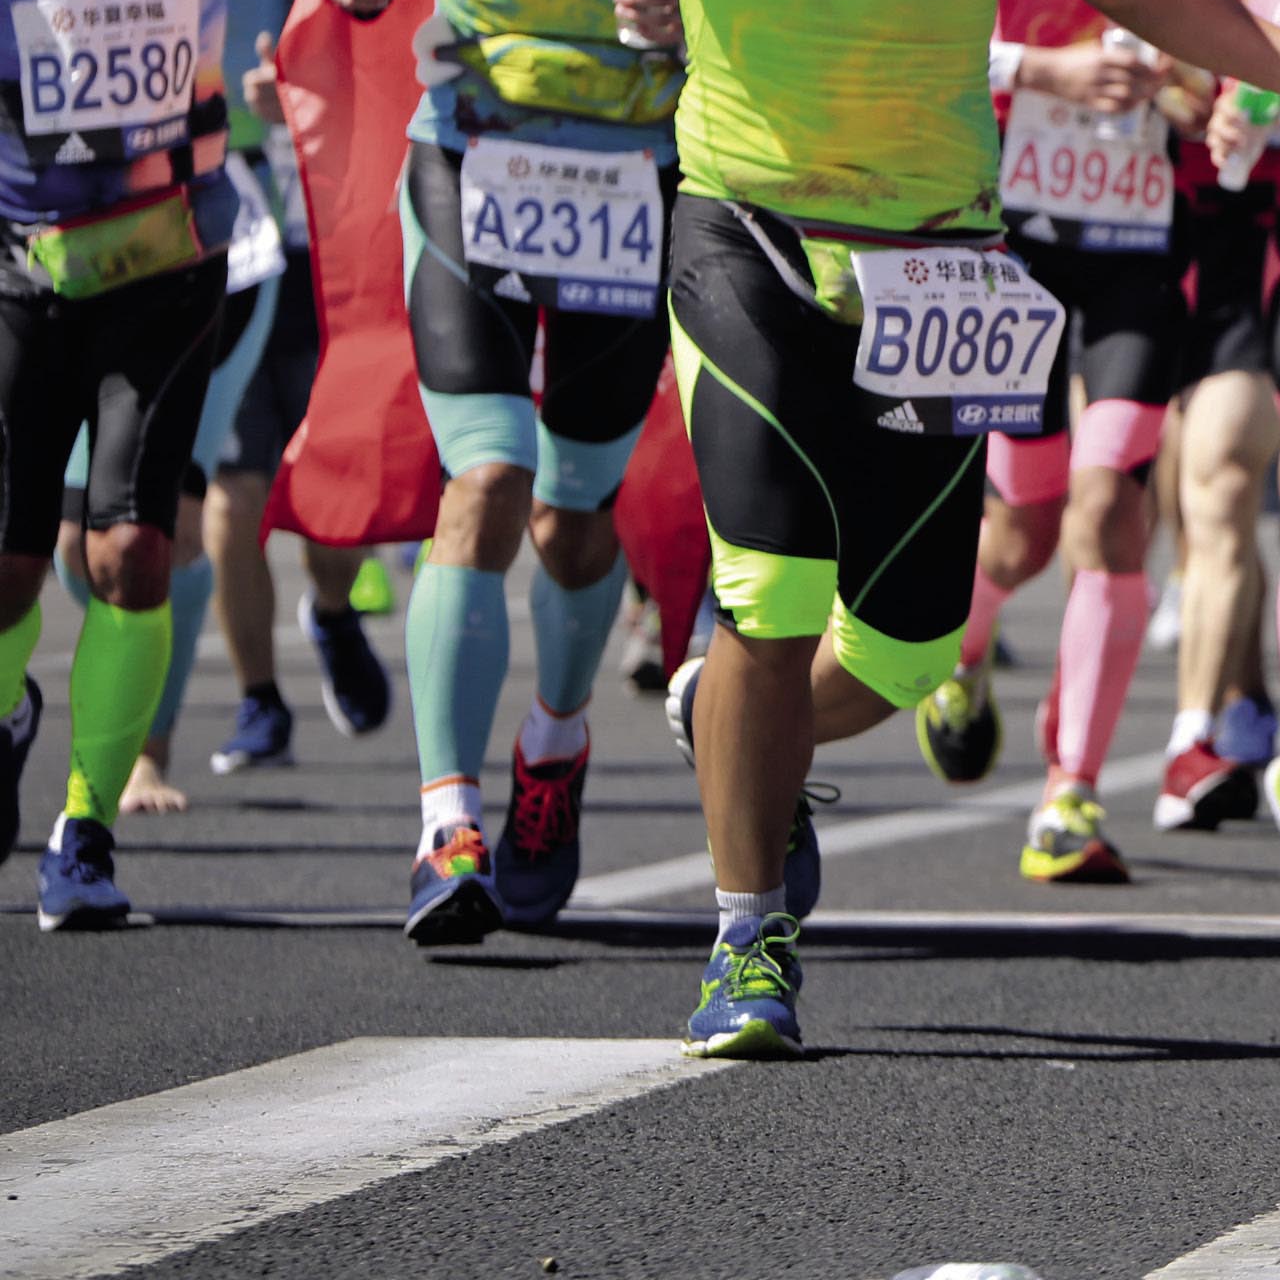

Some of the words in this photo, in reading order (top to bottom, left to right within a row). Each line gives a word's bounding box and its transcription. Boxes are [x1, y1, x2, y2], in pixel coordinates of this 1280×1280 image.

[29, 39, 192, 113] B2580
[1007, 140, 1166, 209] A9946
[472, 192, 653, 264] A2314
[936, 259, 1020, 283] 华夏幸福
[866, 306, 1057, 376] B0867
